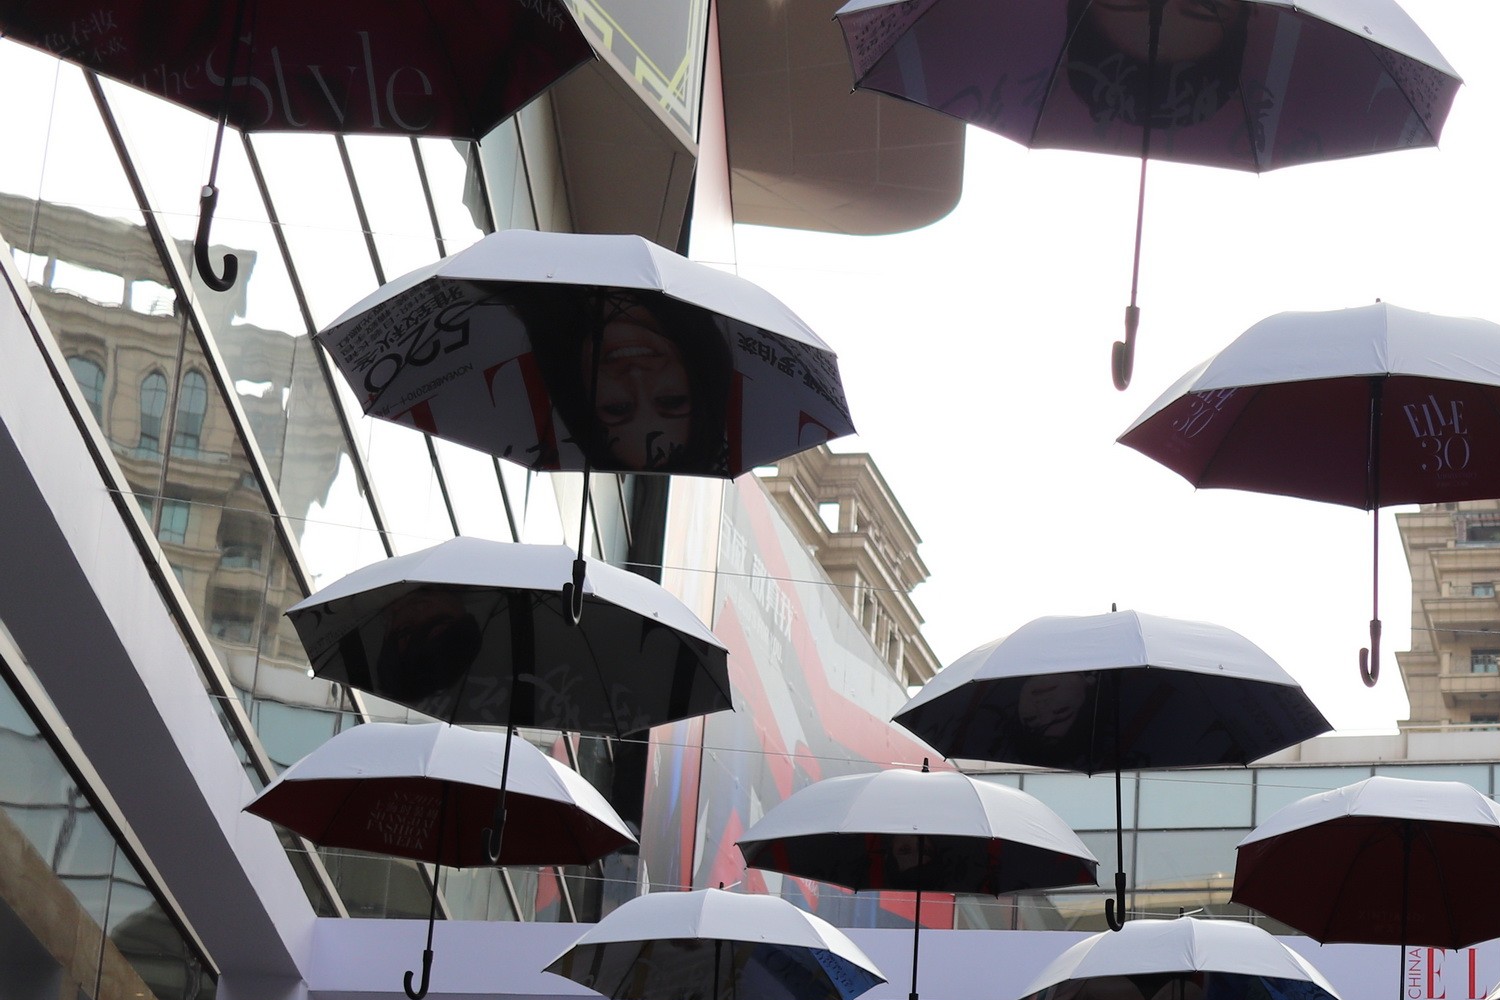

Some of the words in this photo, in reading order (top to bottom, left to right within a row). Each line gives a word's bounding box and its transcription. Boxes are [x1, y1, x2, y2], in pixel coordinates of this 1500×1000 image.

[205, 30, 433, 131] Style
[363, 300, 472, 396] 520
[1403, 394, 1468, 438] ELLE
[1420, 436, 1471, 472] 30
[1408, 948, 1421, 999] CHINA
